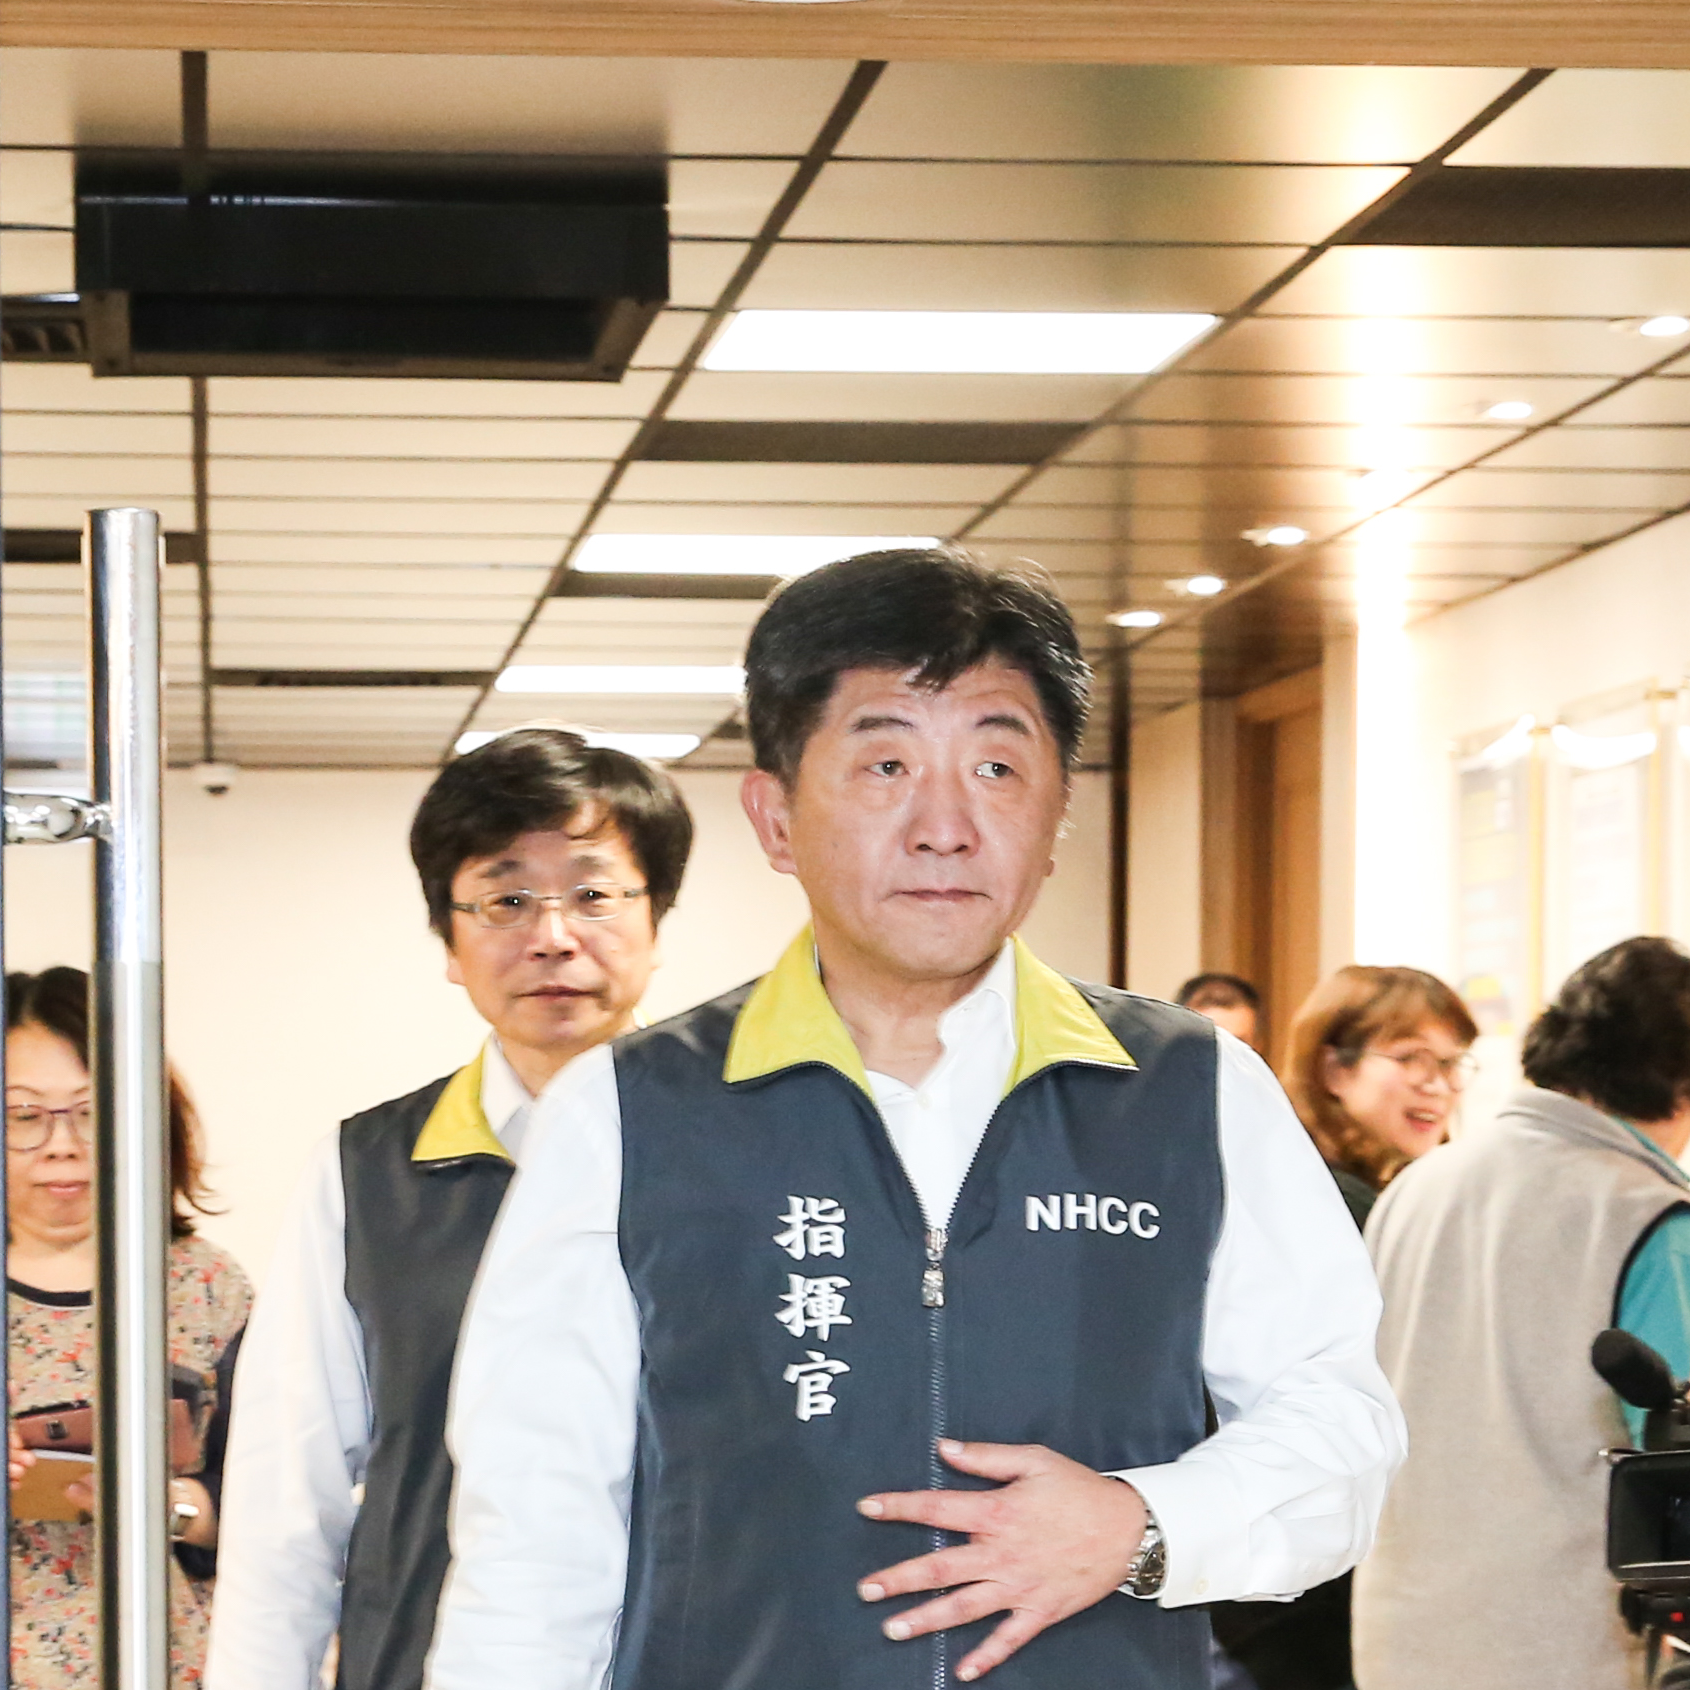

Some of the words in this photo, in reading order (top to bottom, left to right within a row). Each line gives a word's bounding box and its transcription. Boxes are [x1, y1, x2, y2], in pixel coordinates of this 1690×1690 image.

[1025, 1192, 1161, 1240] NHCC
[773, 1194, 853, 1422] 指揮官
